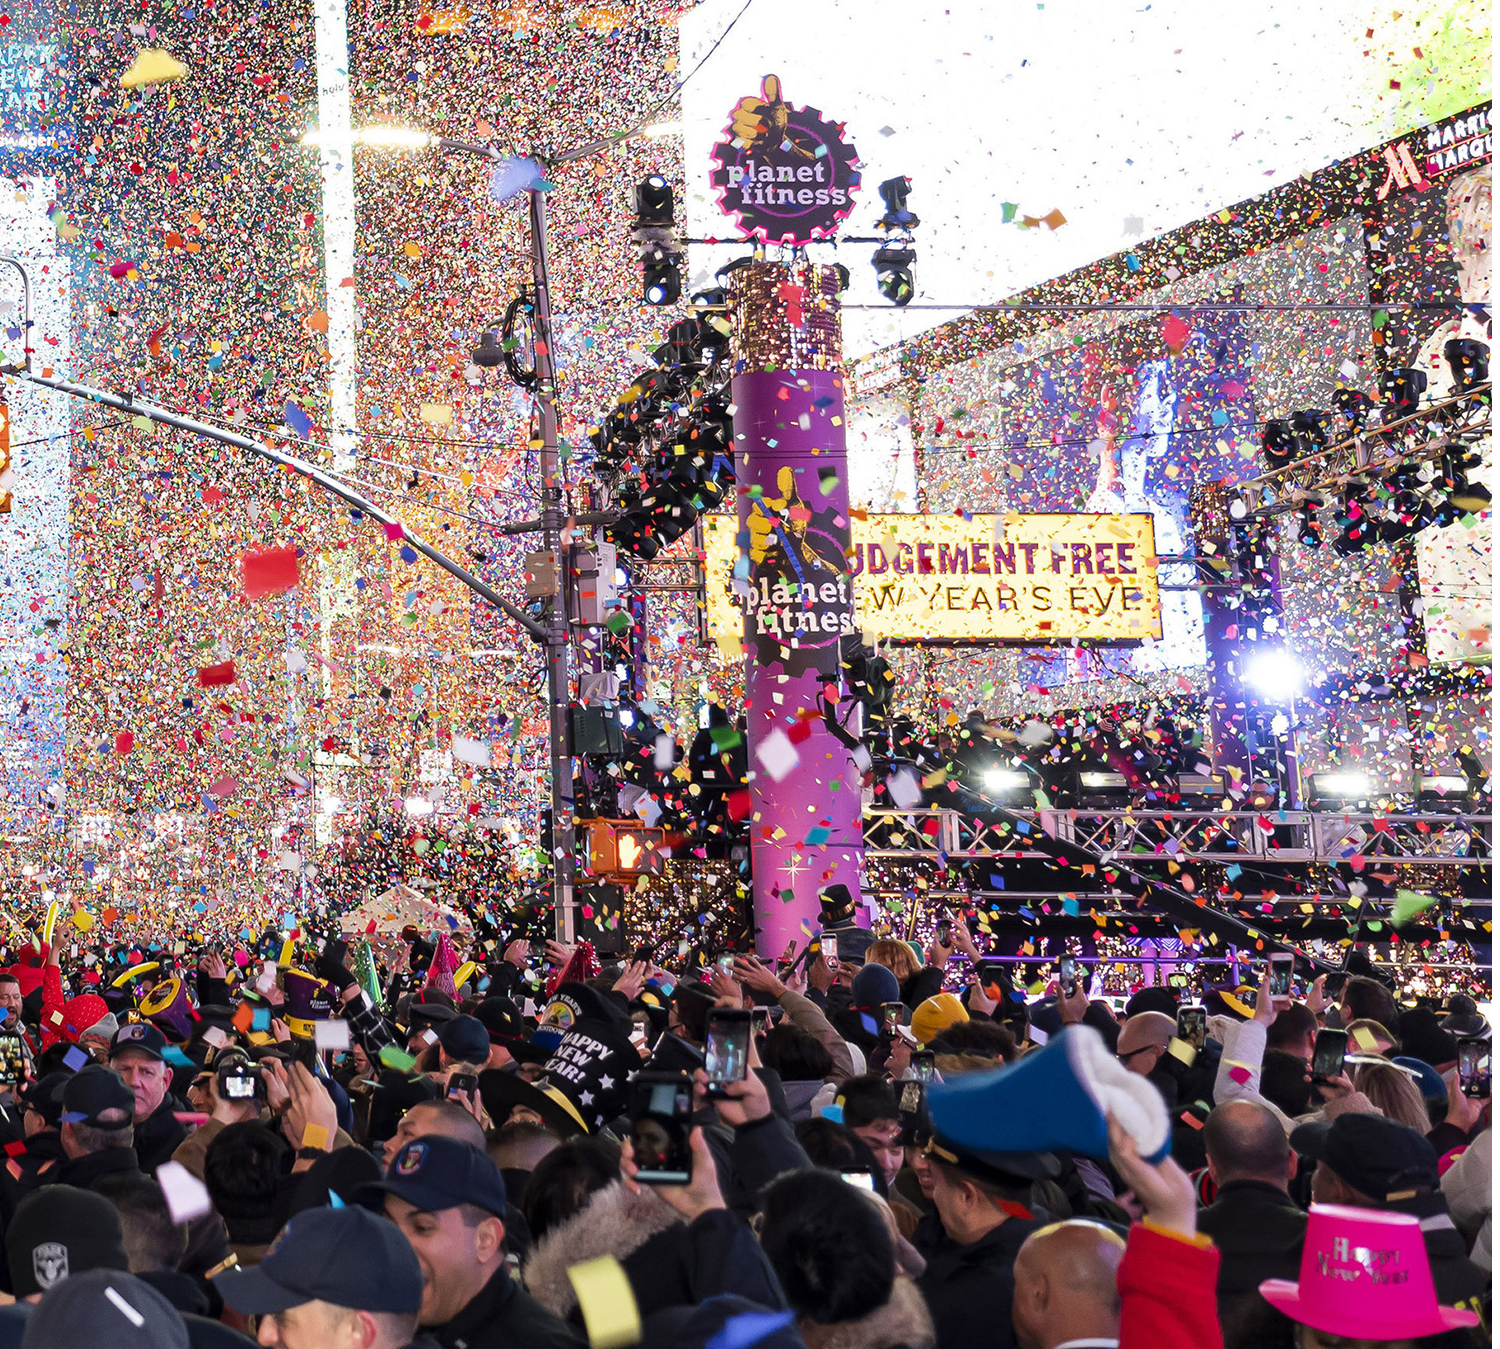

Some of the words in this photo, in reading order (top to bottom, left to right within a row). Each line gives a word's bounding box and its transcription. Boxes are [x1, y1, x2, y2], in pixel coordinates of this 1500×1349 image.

[726, 159, 825, 189] planet
[740, 180, 847, 208] fitness
[854, 541, 1041, 577] UDGEMENT
[1049, 541, 1139, 577] FREE
[744, 571, 849, 609] planet
[855, 586, 907, 612] EW
[927, 585, 1052, 612] YEAR'S
[1069, 585, 1142, 613] EVE
[554, 1044, 592, 1070] NEW
[559, 1029, 614, 1061] HAPPY
[544, 1058, 588, 1084] EAR!
[1333, 1236, 1400, 1268] Happy
[1316, 1254, 1363, 1283] New
[1369, 1264, 1410, 1286] Year
